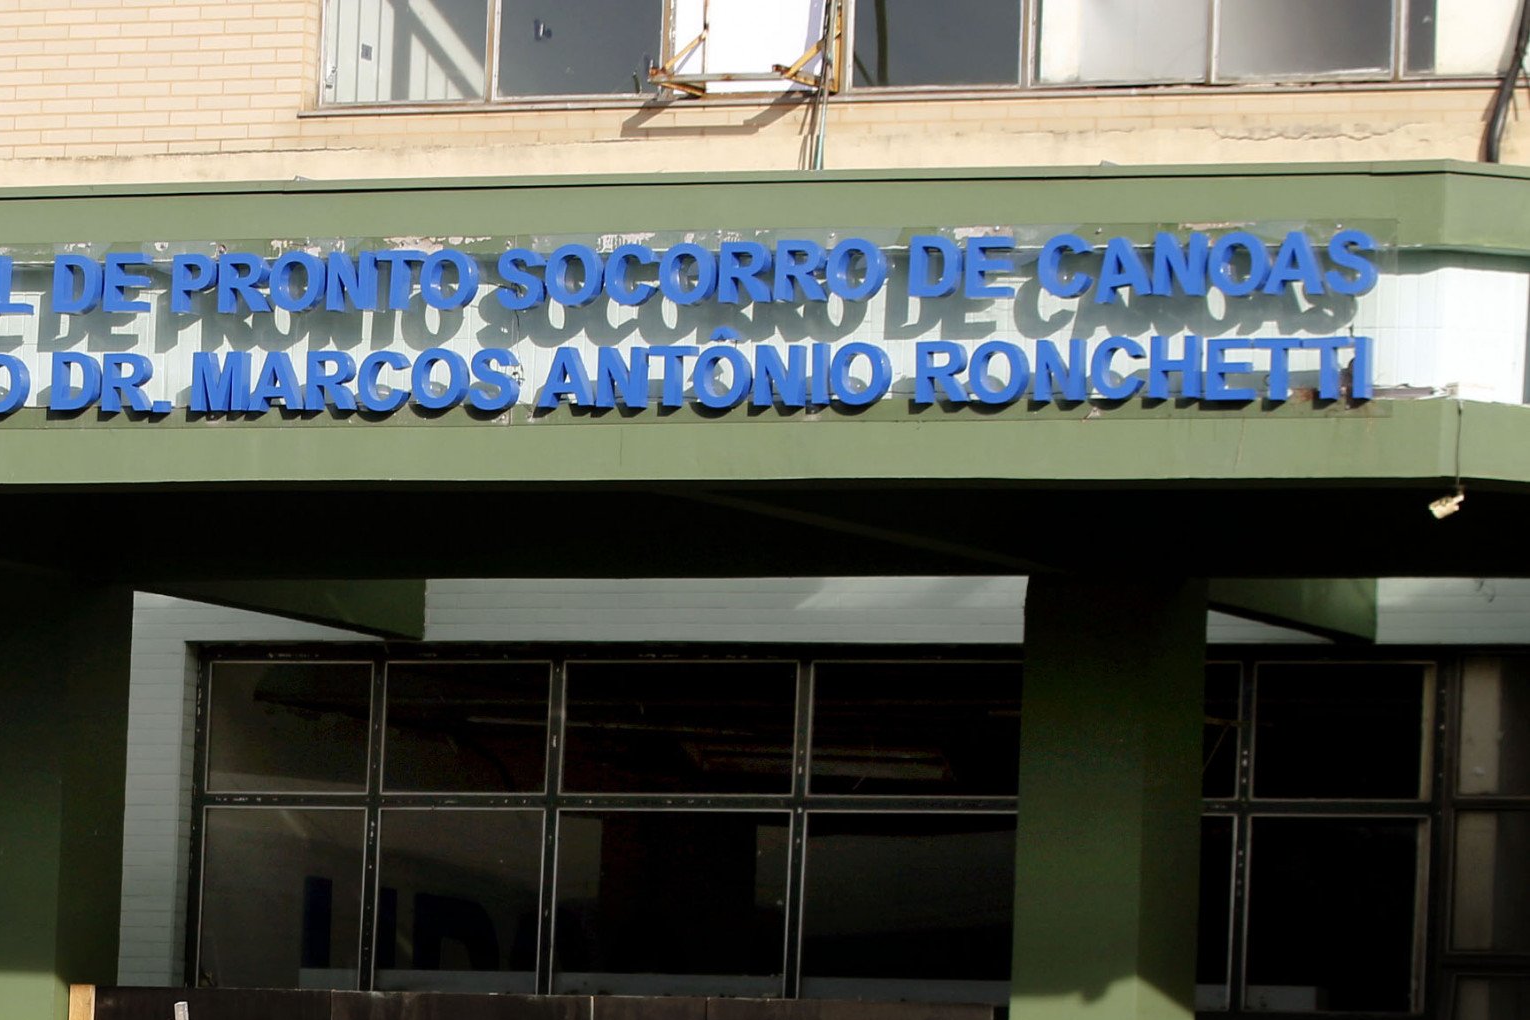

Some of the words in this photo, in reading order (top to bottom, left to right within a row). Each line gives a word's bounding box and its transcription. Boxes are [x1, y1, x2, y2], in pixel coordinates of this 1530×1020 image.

[51, 252, 152, 315] DE
[170, 249, 480, 315] PRONTO
[496, 237, 889, 312] SOCORRO
[907, 235, 1015, 299] DE
[1036, 230, 1378, 305] CANOAS
[48, 351, 173, 415] DR.
[188, 347, 521, 413] MARCOS
[537, 327, 893, 410] ANTÔNIO
[913, 335, 1373, 405] RONCHETTI
